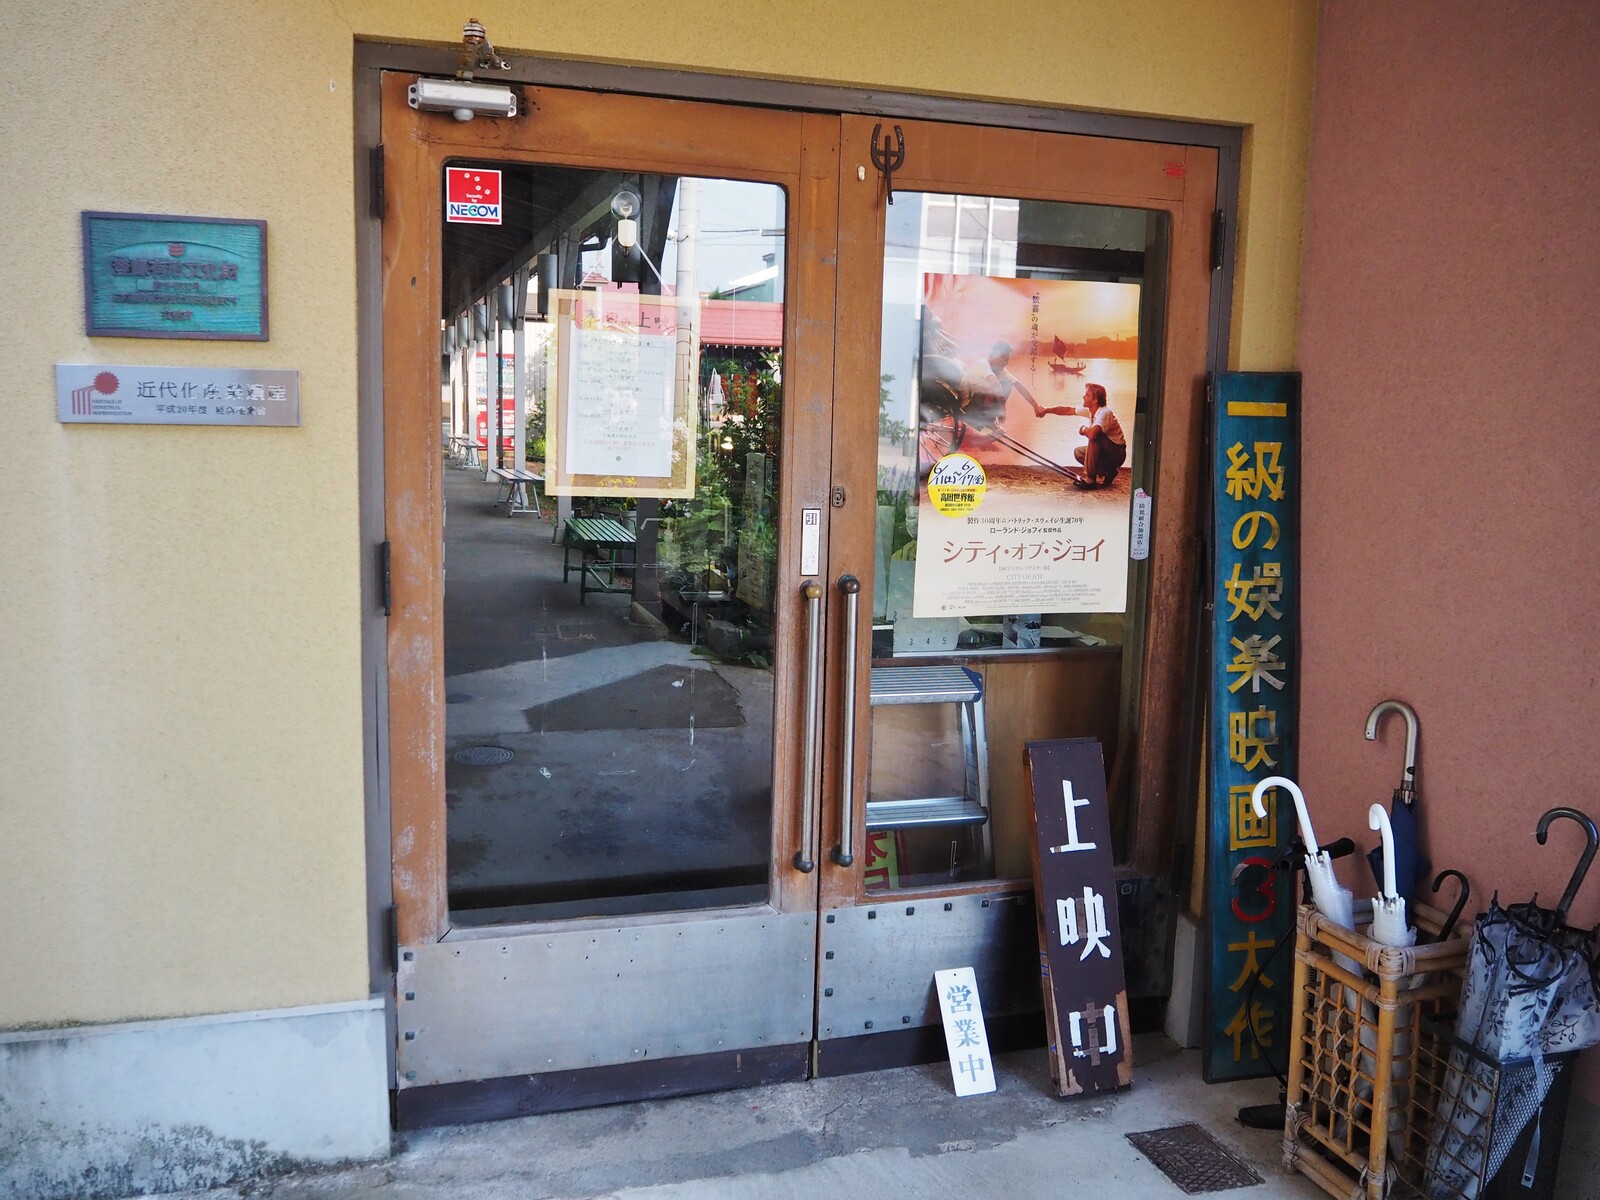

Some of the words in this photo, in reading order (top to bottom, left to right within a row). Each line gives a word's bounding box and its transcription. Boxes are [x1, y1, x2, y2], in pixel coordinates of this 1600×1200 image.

[450, 204, 498, 218] NECOM
[137, 381, 288, 401] 近代化産業遺産
[156, 404, 208, 415] 平成20年度
[940, 493, 975, 502] 高田世界館
[943, 538, 1106, 565] シティ・オブ・ジョイ
[1223, 402, 1287, 1062] 一級の娯楽映画3大作
[1049, 779, 1118, 1067] 上映中
[946, 985, 986, 1083] 営業中
